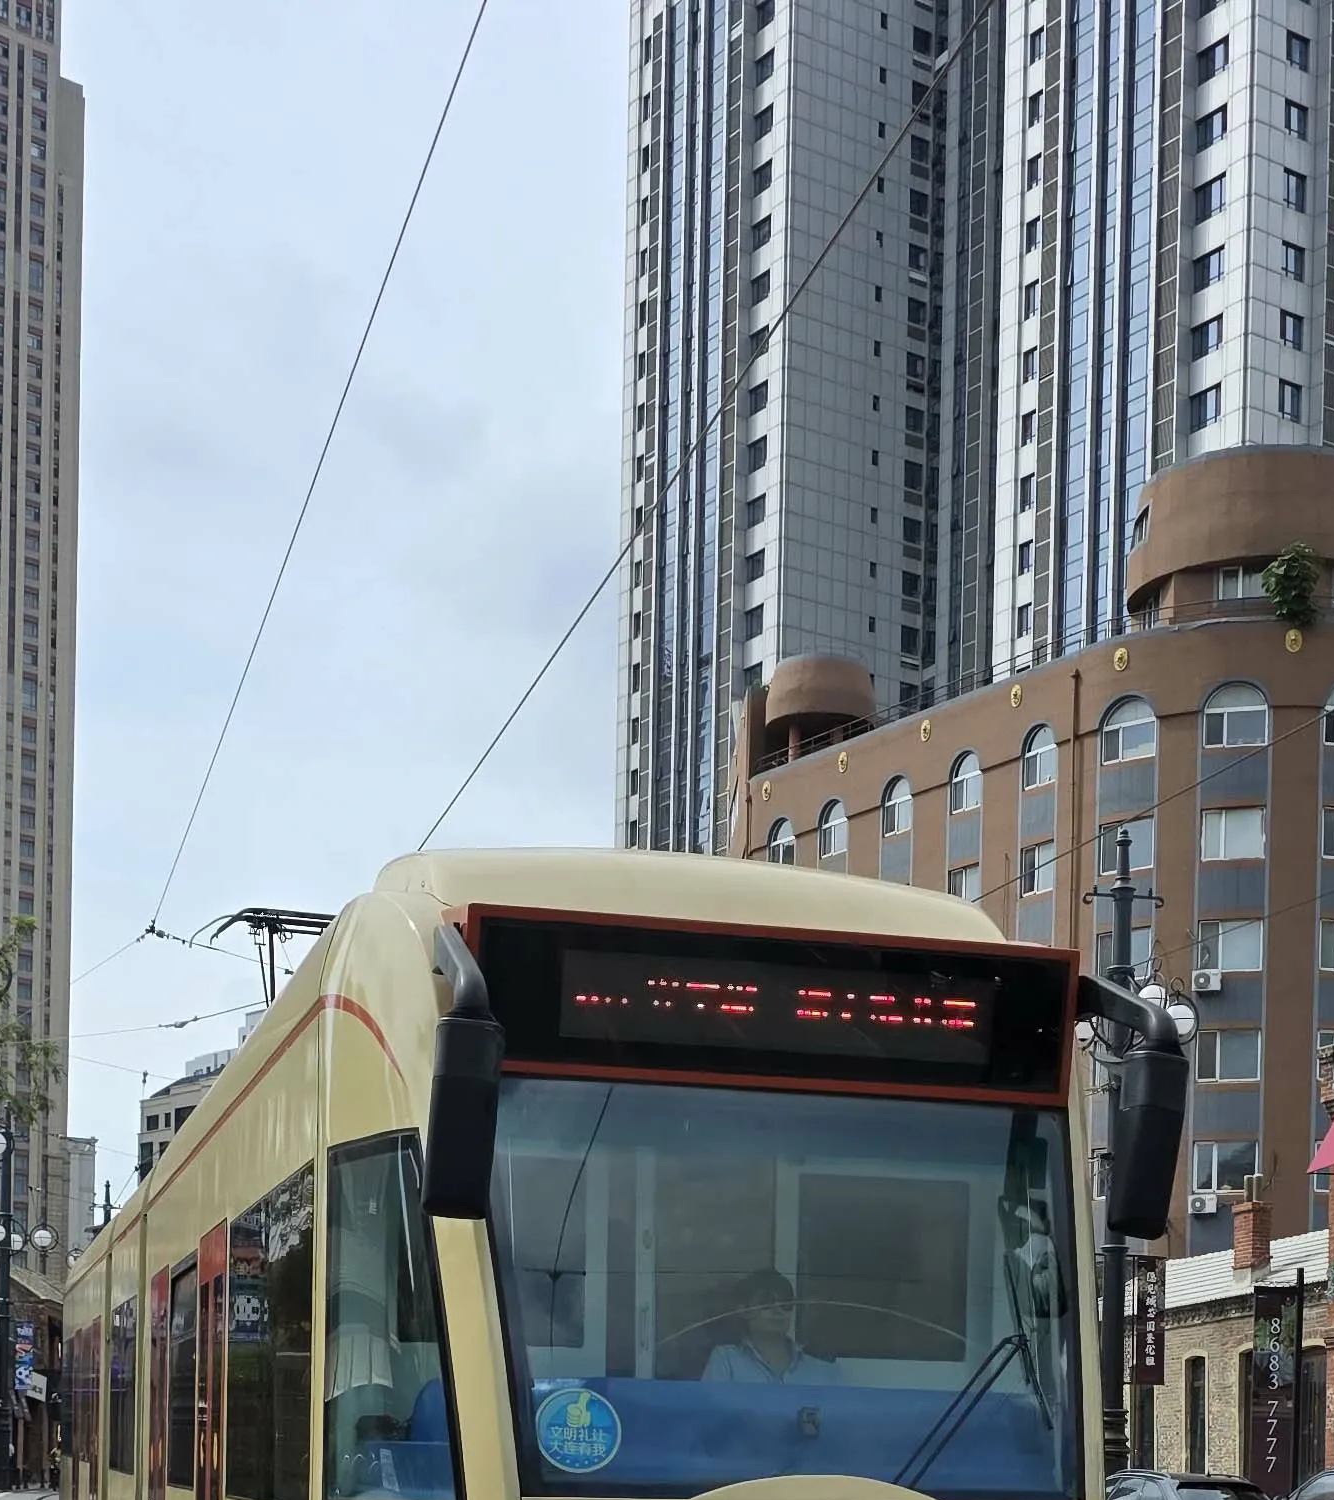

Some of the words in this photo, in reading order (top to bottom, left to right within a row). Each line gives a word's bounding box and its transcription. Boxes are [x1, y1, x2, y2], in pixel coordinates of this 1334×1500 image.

[1268, 1317, 1281, 1390] 8683
[548, 1426, 607, 1442] 文明礼让
[548, 1440, 606, 1457] 大连有我
[1265, 1400, 1278, 1473] 7777
